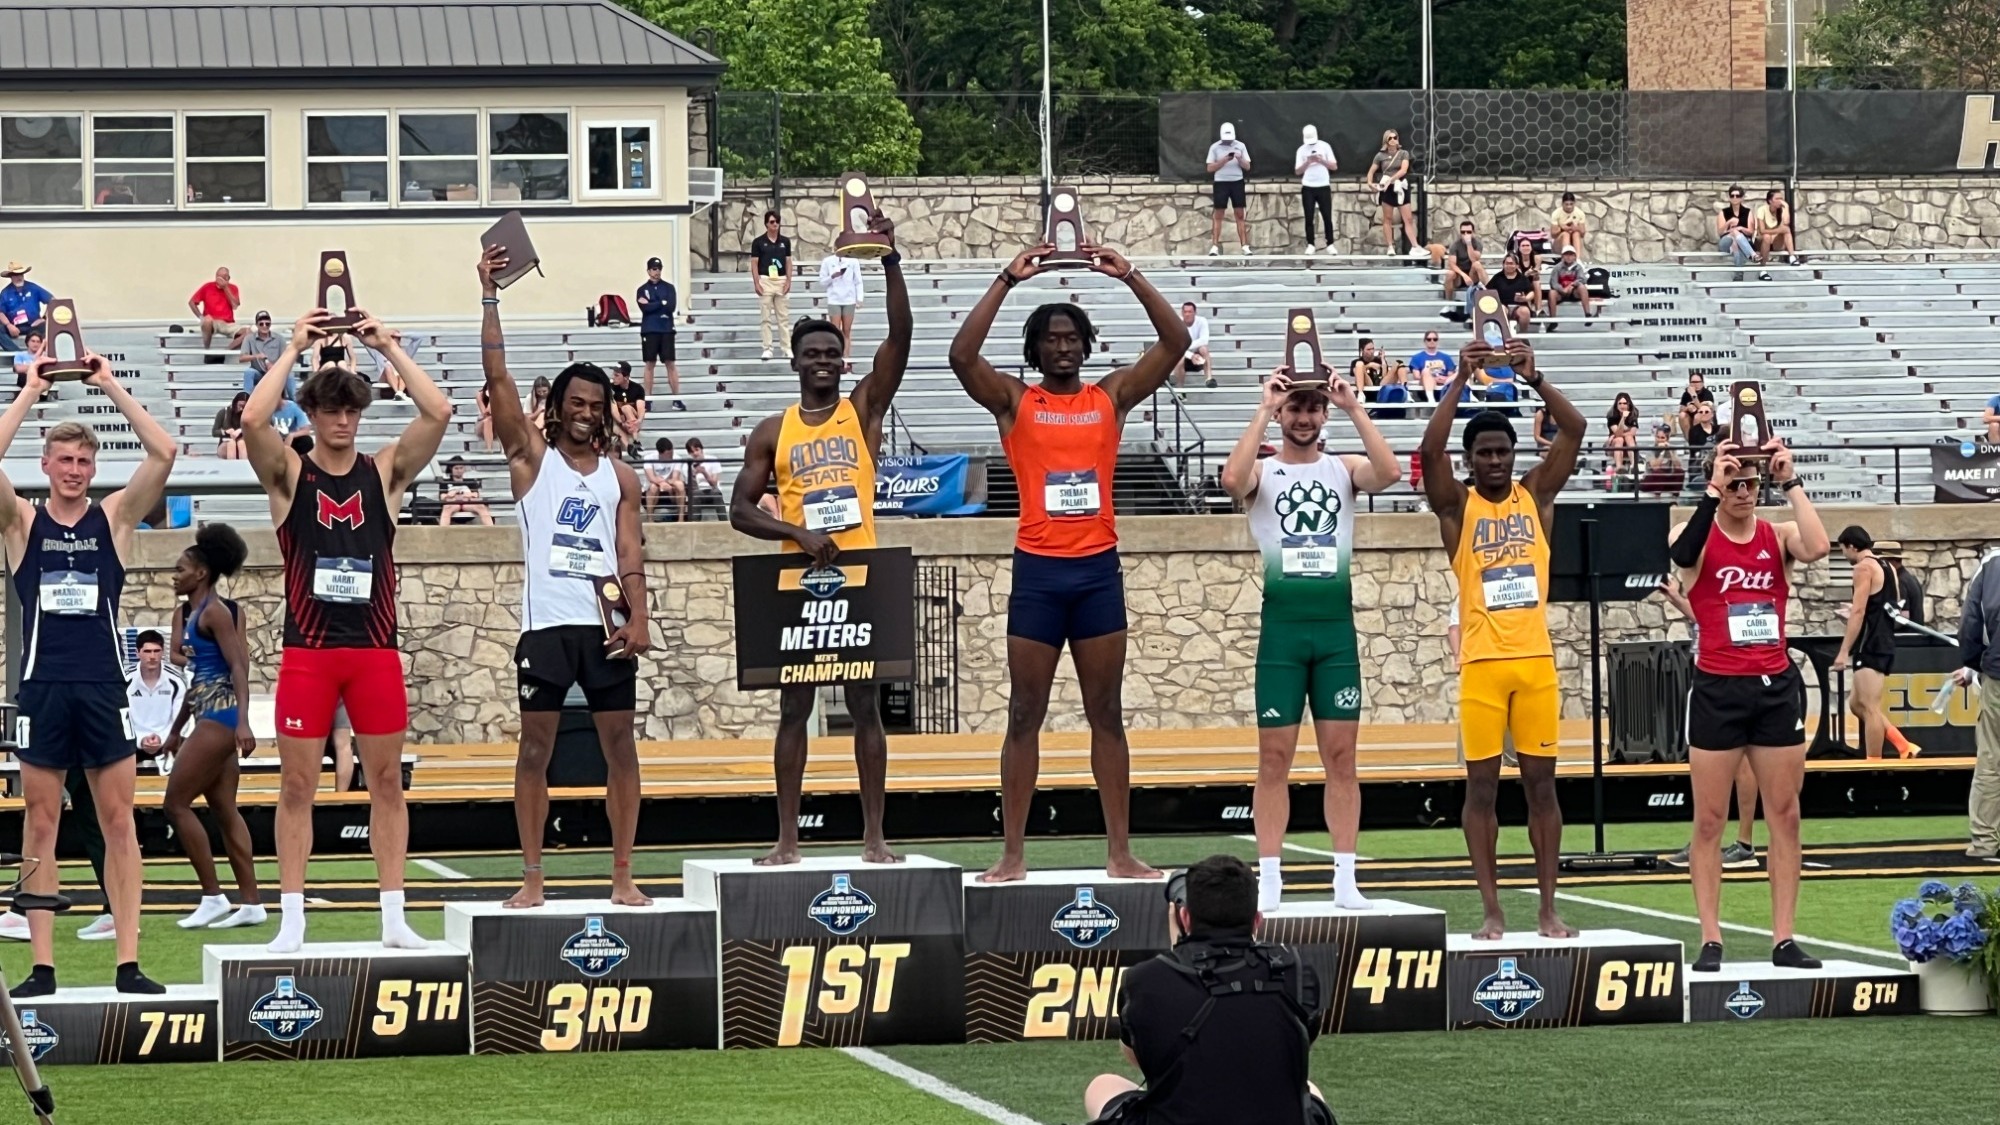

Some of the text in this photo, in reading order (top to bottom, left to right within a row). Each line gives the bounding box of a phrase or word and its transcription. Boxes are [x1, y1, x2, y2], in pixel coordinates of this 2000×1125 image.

[1632, 302, 1674, 310] HORNETS
[1660, 317, 1707, 326] STUDENTS
[1660, 334, 1702, 342] HORNETS
[1689, 350, 1737, 359] STUDENTS
[790, 435, 858, 474] Angelo
[802, 468, 852, 487] STATE
[1944, 468, 1997, 480] MAKE IT
[884, 473, 940, 498] YOURS
[1060, 488, 1088, 498] SHEMAR
[1061, 498, 1088, 507] PALMER
[317, 489, 364, 531] M
[556, 496, 600, 533] GV
[817, 504, 848, 516] WILLIAM
[1293, 510, 1323, 533] N
[566, 552, 592, 561] JOSHUA
[569, 561, 586, 571] PAGE
[1625, 574, 1663, 588] GILL
[1716, 566, 1774, 593] Pitt
[52, 588, 87, 597] BRANDON
[326, 584, 359, 595] MITCHELL
[56, 598, 83, 606] ROGERS
[801, 599, 849, 624] 400
[780, 623, 872, 651] METERS
[815, 654, 838, 663] MEN'S
[780, 661, 875, 684] CHAMPION
[1648, 793, 1684, 806] GILL
[797, 814, 824, 828] ILL
[340, 825, 369, 838] GIL
[811, 905, 874, 915] CHAMPIONSHIPS
[1053, 919, 1117, 928] CHAMPIONSHIPS
[563, 947, 627, 957] CHAMPIONSHIPS
[1352, 948, 1442, 1004] 4TH
[1595, 960, 1675, 1011] 6TH
[778, 943, 911, 1046] 1ST
[1475, 990, 1541, 1000] CHAMPIONSHIPS
[1853, 981, 1898, 1012] 8TH
[372, 980, 463, 1035] 5TH
[251, 1010, 320, 1020] CHAMPIONSHIPS
[540, 983, 653, 1051] 3RD
[139, 1012, 205, 1056] 7TH
